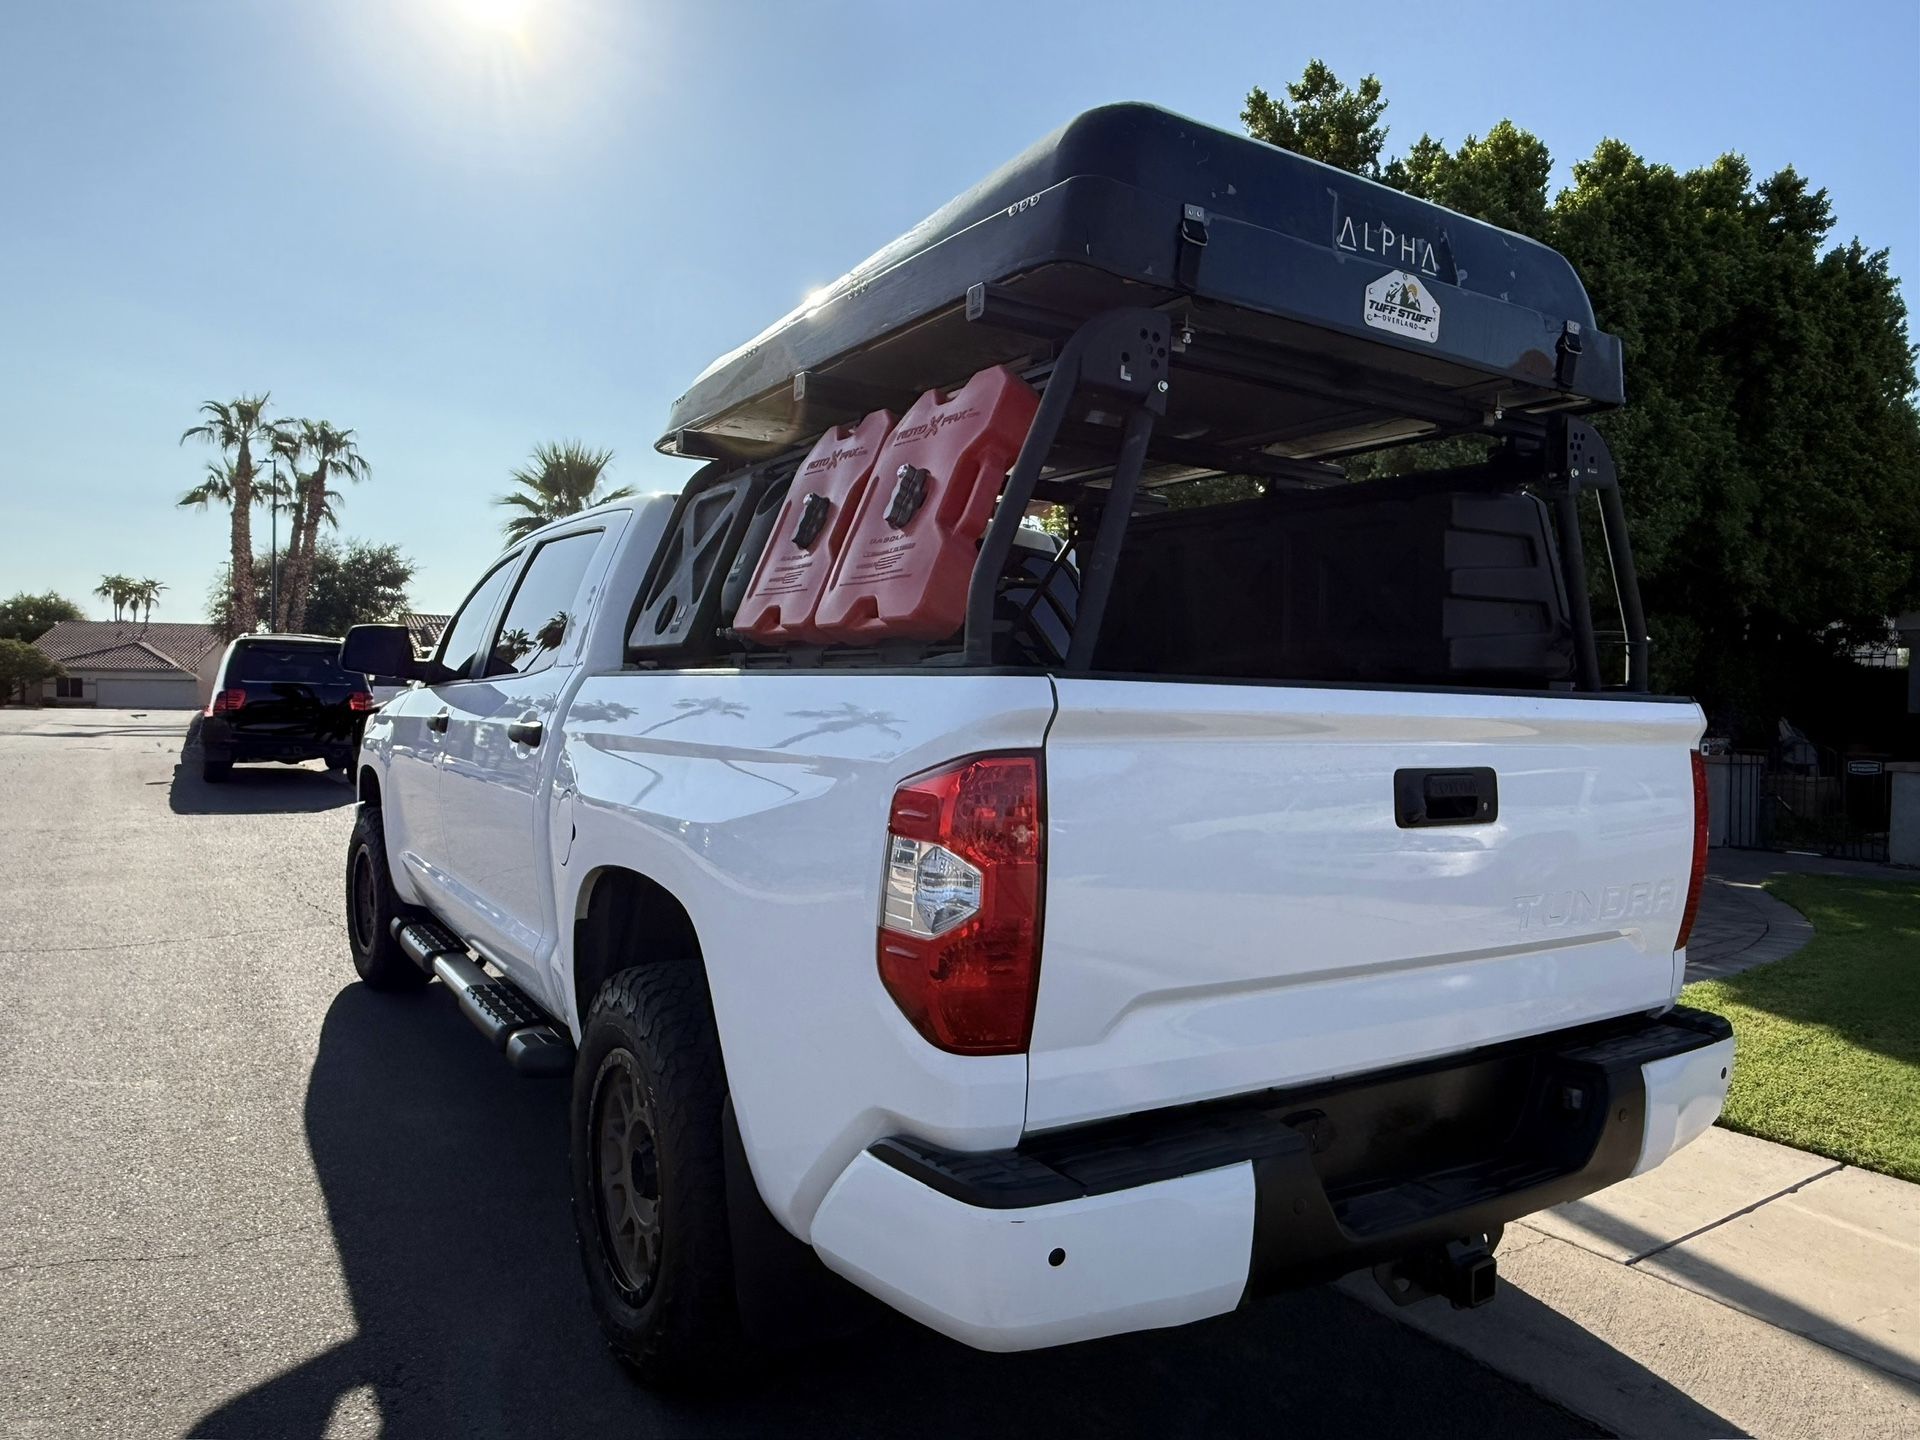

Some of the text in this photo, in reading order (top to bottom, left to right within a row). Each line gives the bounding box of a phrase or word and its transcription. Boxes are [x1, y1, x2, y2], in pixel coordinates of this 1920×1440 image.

[1339, 216, 1437, 276] ALPHA
[1368, 299, 1433, 325] TUFF STUFF
[1382, 314, 1418, 330] OVERLAND
[1512, 878, 1679, 931] TUNDRA
